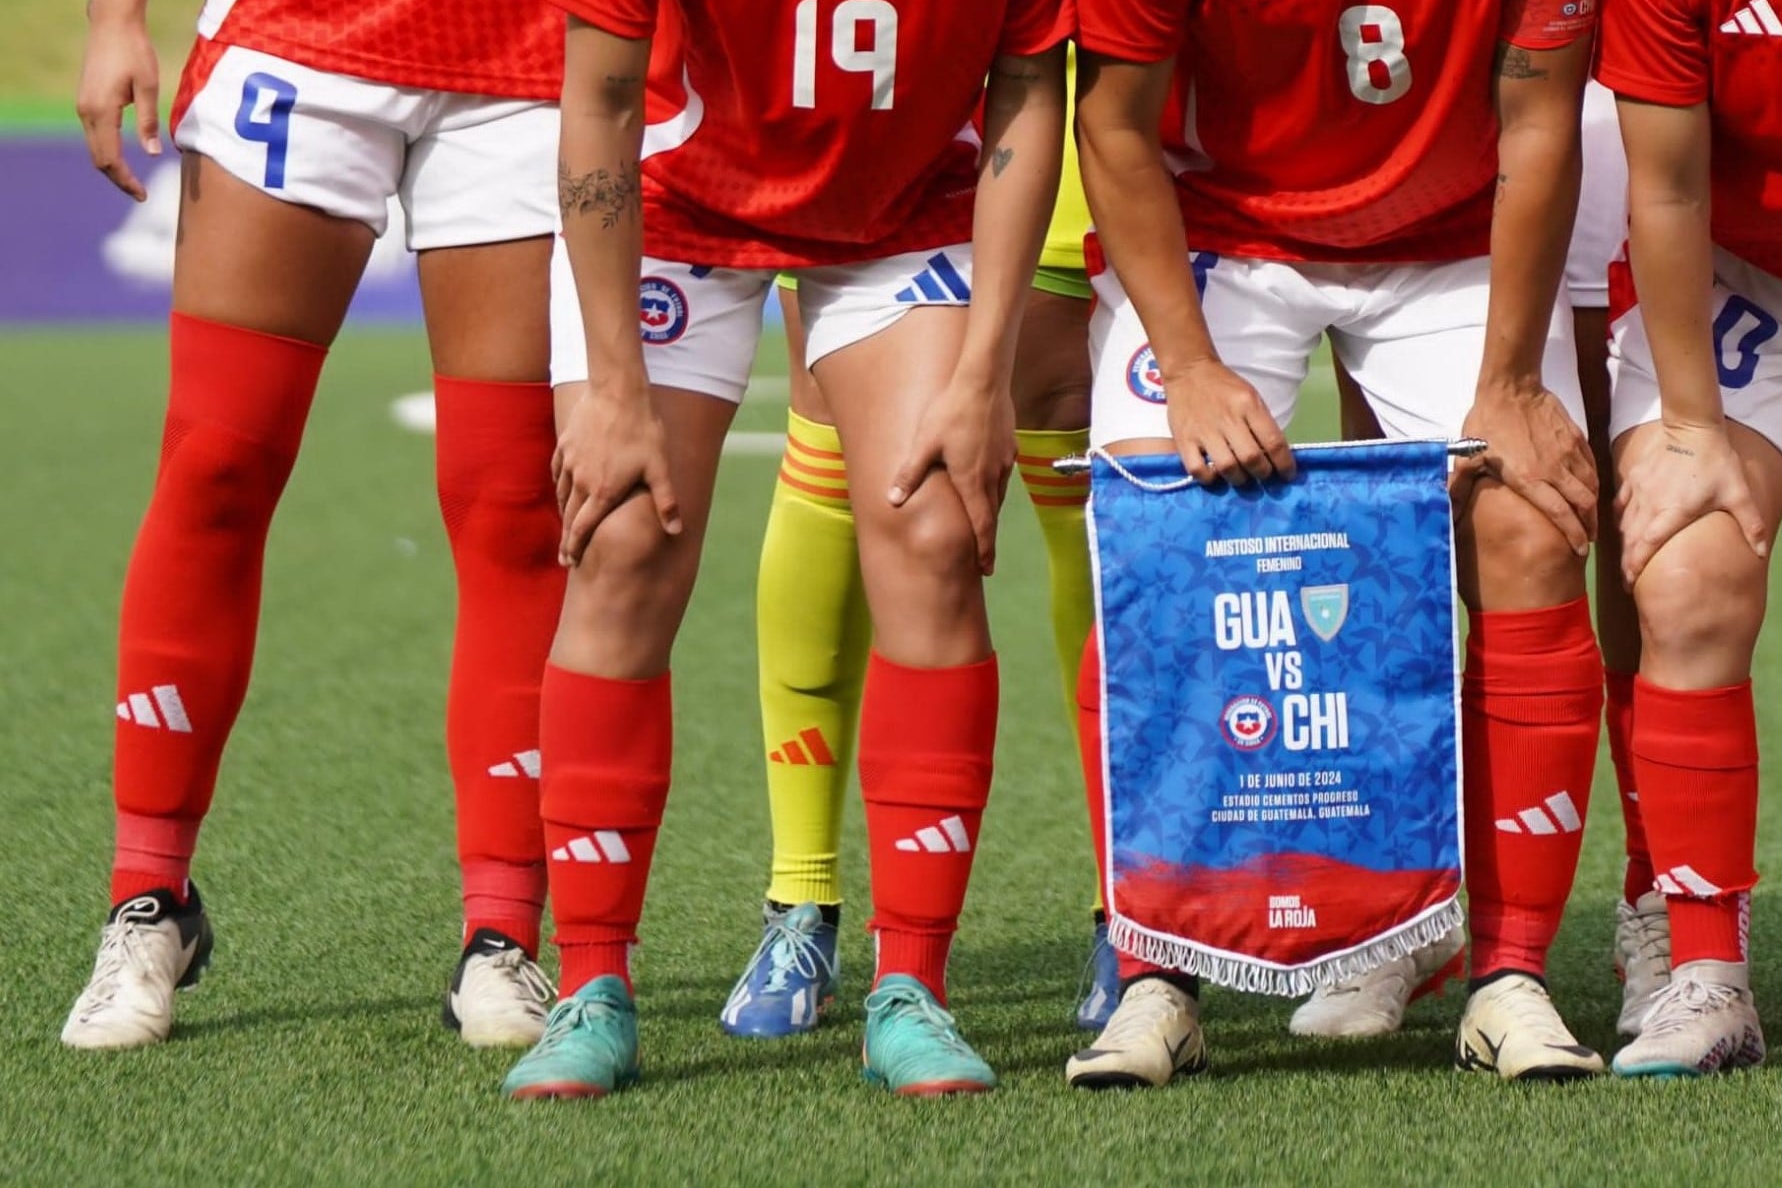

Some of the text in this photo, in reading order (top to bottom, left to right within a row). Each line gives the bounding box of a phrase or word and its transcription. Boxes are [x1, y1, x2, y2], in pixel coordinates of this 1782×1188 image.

[1339, 4, 1411, 105] 8
[235, 72, 298, 189] 9
[1205, 532, 1350, 557] AMISTOSO INTERNACIONAL
[1256, 556, 1302, 573] FEMENINO
[1214, 590, 1297, 650] GUA
[1265, 651, 1302, 690] VS
[1283, 693, 1348, 750] CHI
[1239, 771, 1342, 788] 1 DE JUNIO DE 2024
[1223, 790, 1359, 808] ESTADIO CEMENTOS PROGRESO
[1212, 810, 1245, 823] CIUDAD
[1247, 809, 1259, 822] DE
[1319, 804, 1371, 819] GUATEMALA
[1269, 905, 1317, 929] LA ROJA
